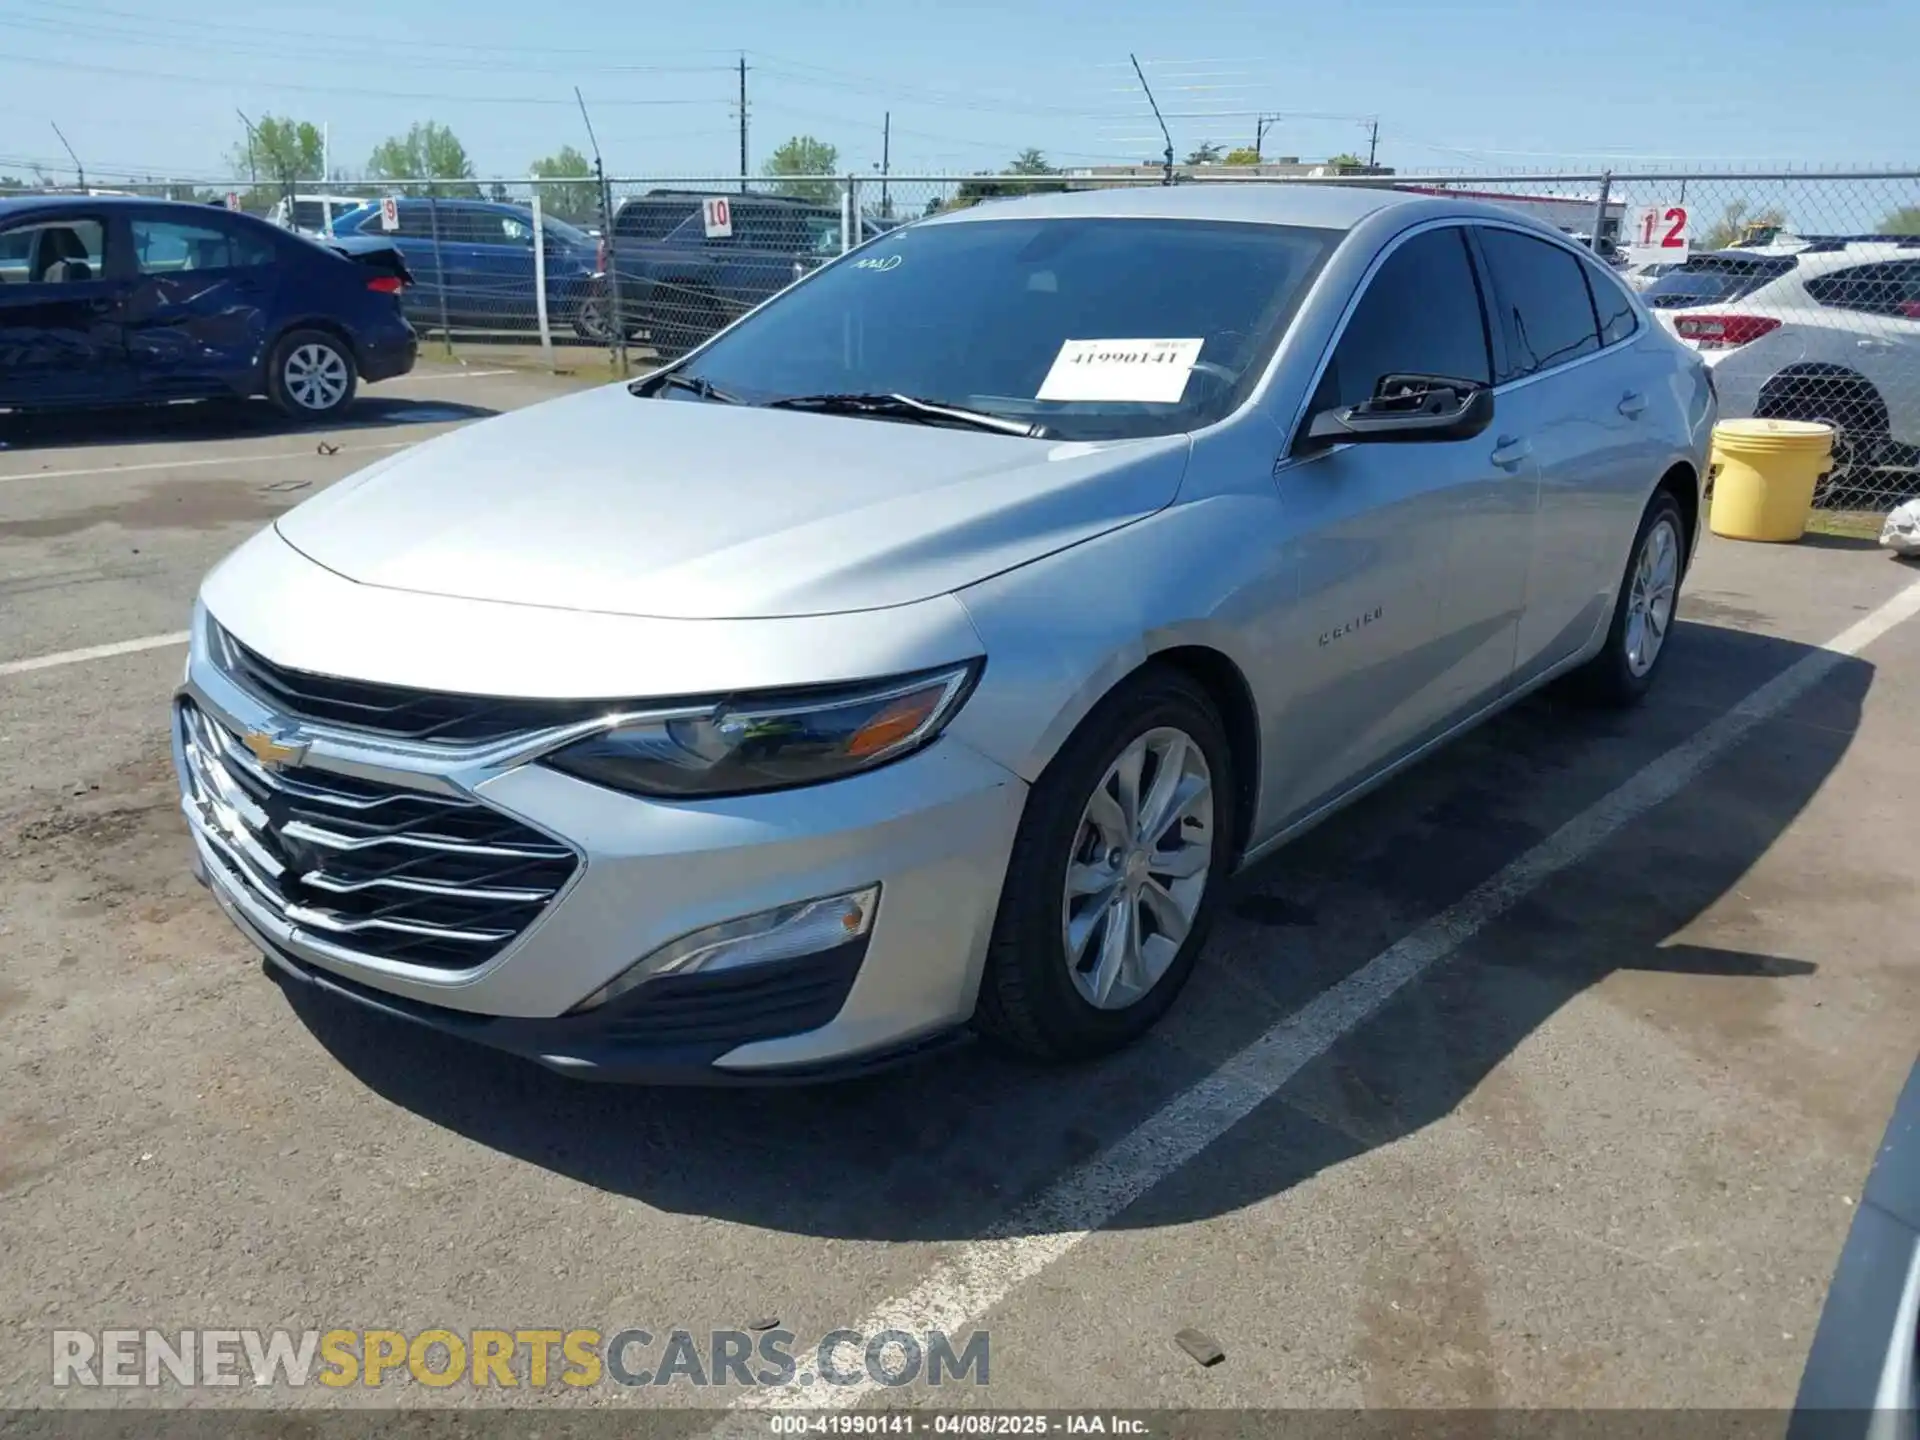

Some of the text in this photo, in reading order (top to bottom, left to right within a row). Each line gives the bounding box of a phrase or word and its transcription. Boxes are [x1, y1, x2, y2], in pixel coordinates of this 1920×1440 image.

[386, 200, 396, 221] 9
[709, 201, 727, 226] 10
[1640, 208, 1687, 248] 12
[1070, 351, 1178, 364] 41990141
